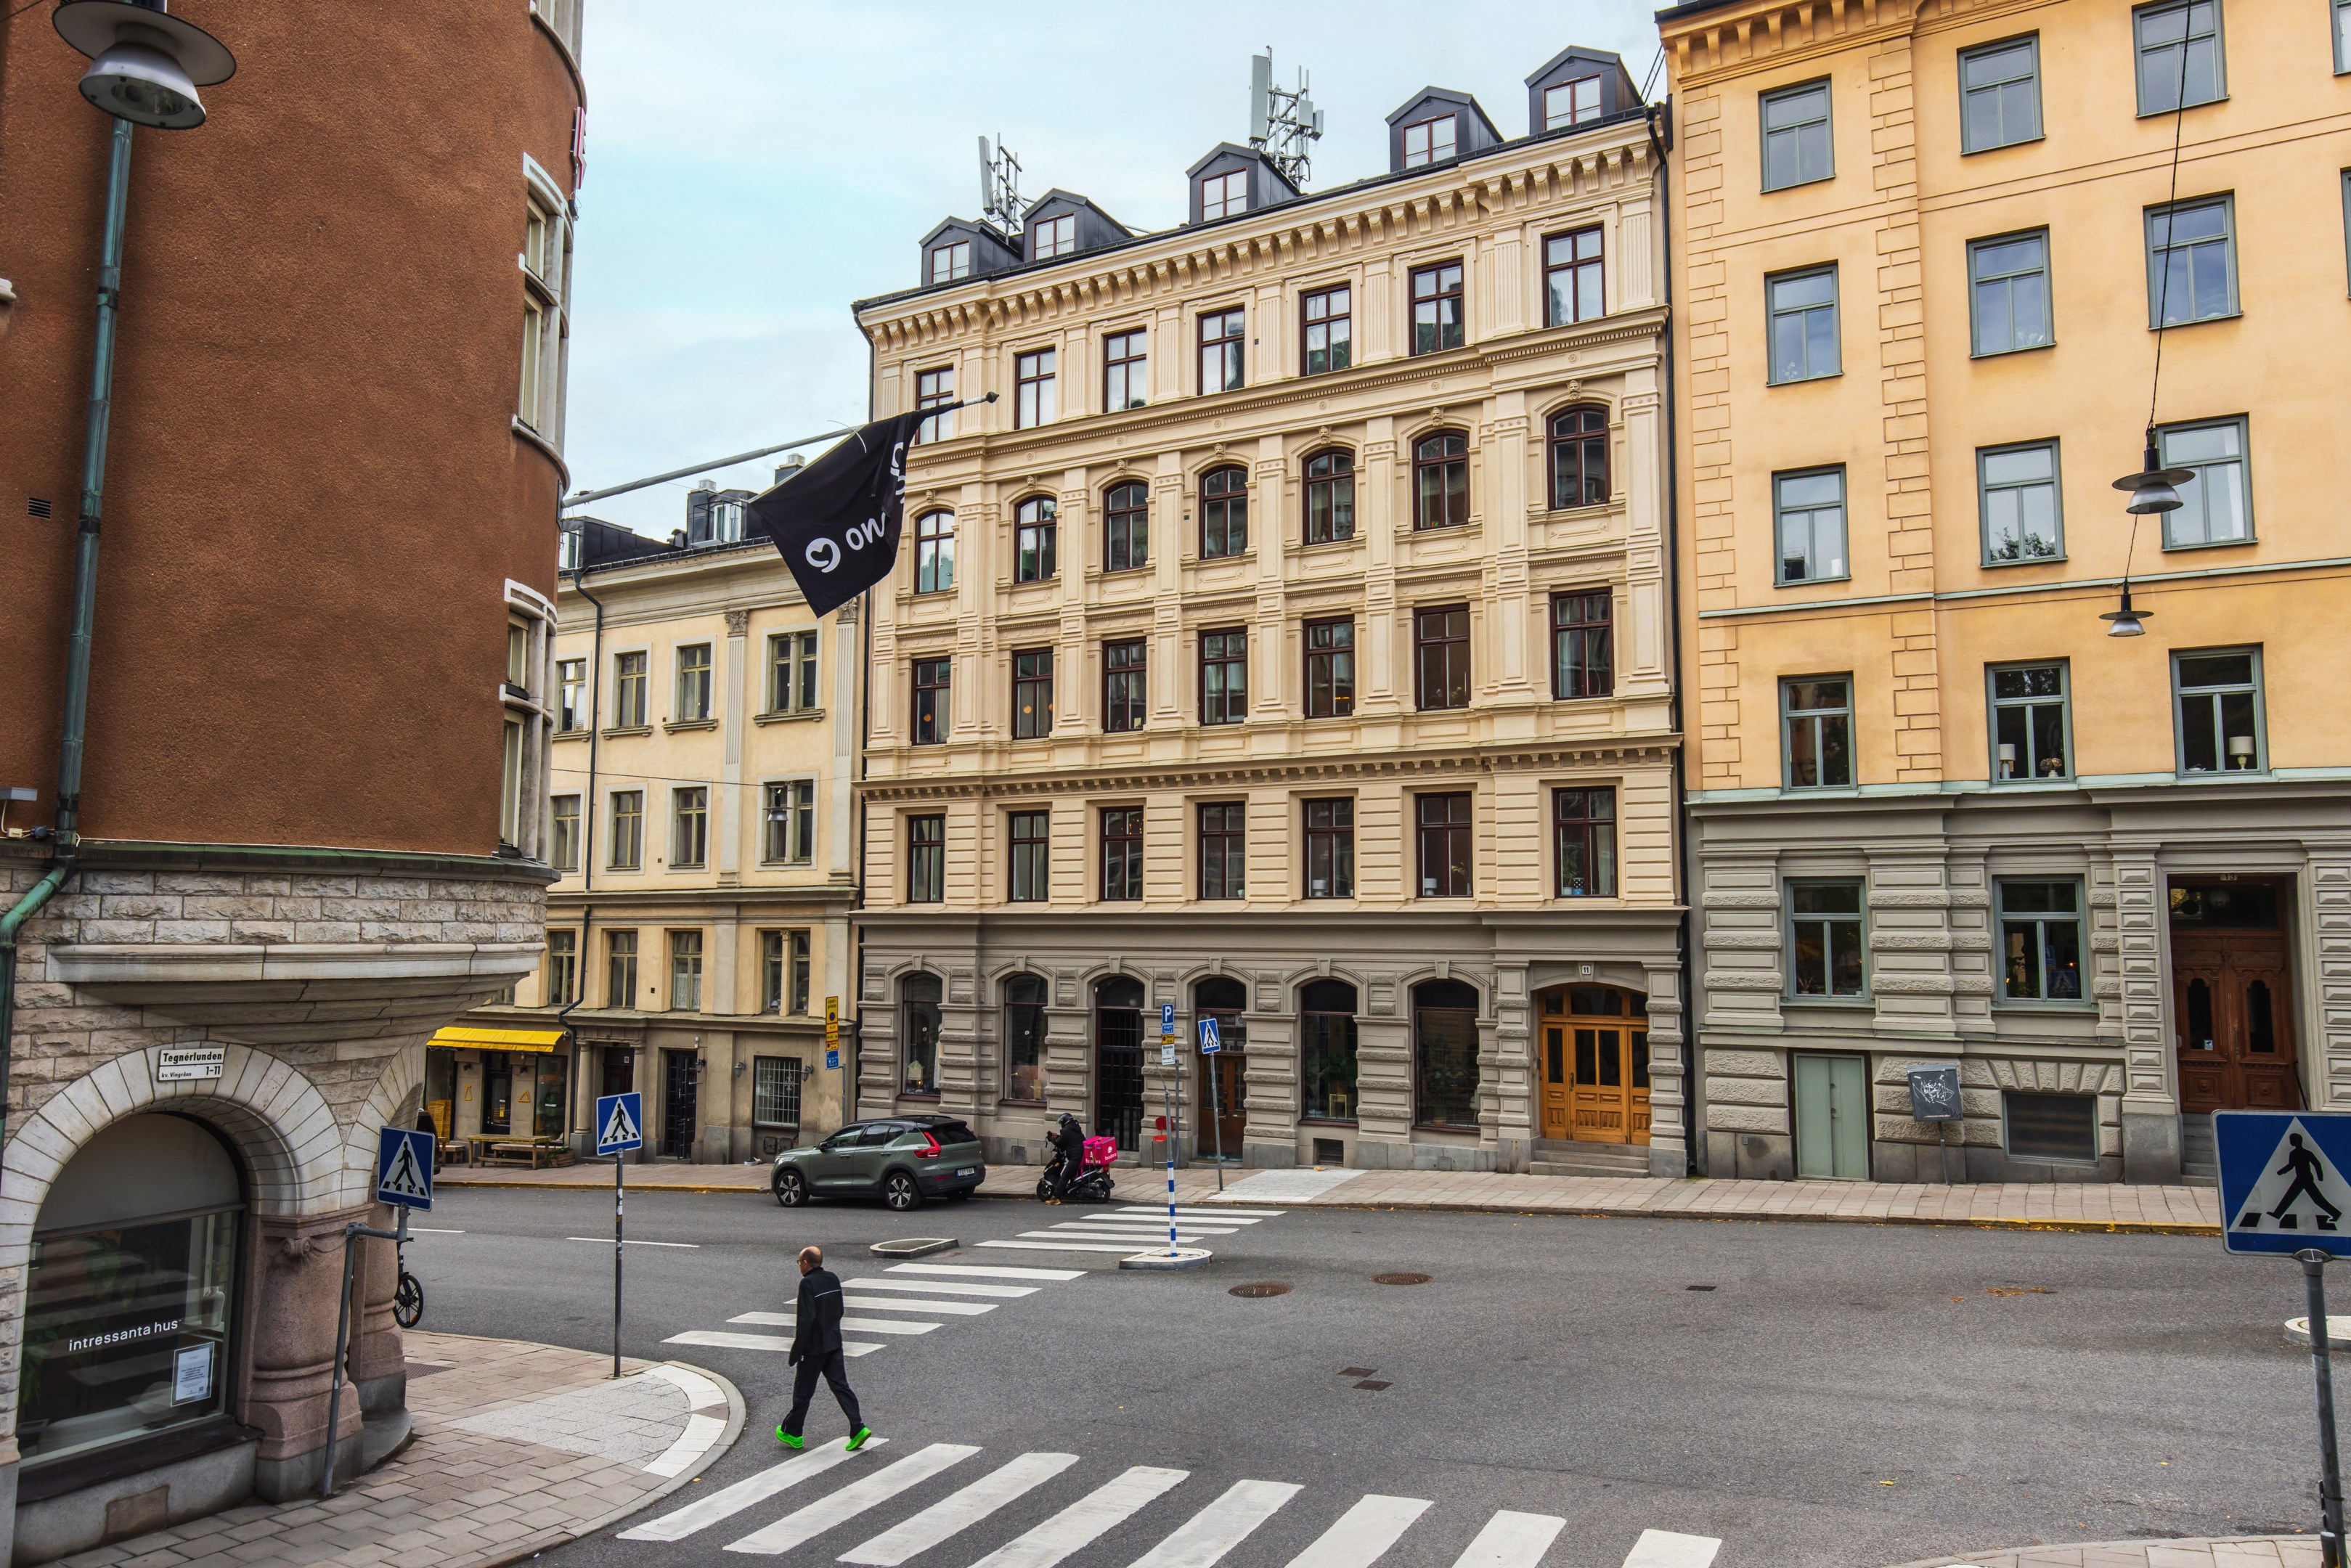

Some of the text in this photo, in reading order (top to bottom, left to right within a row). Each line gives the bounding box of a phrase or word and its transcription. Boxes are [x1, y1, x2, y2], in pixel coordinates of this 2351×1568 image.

[1165, 1005, 1172, 1022] P
[163, 1051, 222, 1064] Tegnérlunden
[205, 1066, 221, 1075] 1-11
[68, 1326, 151, 1352] intressanta
